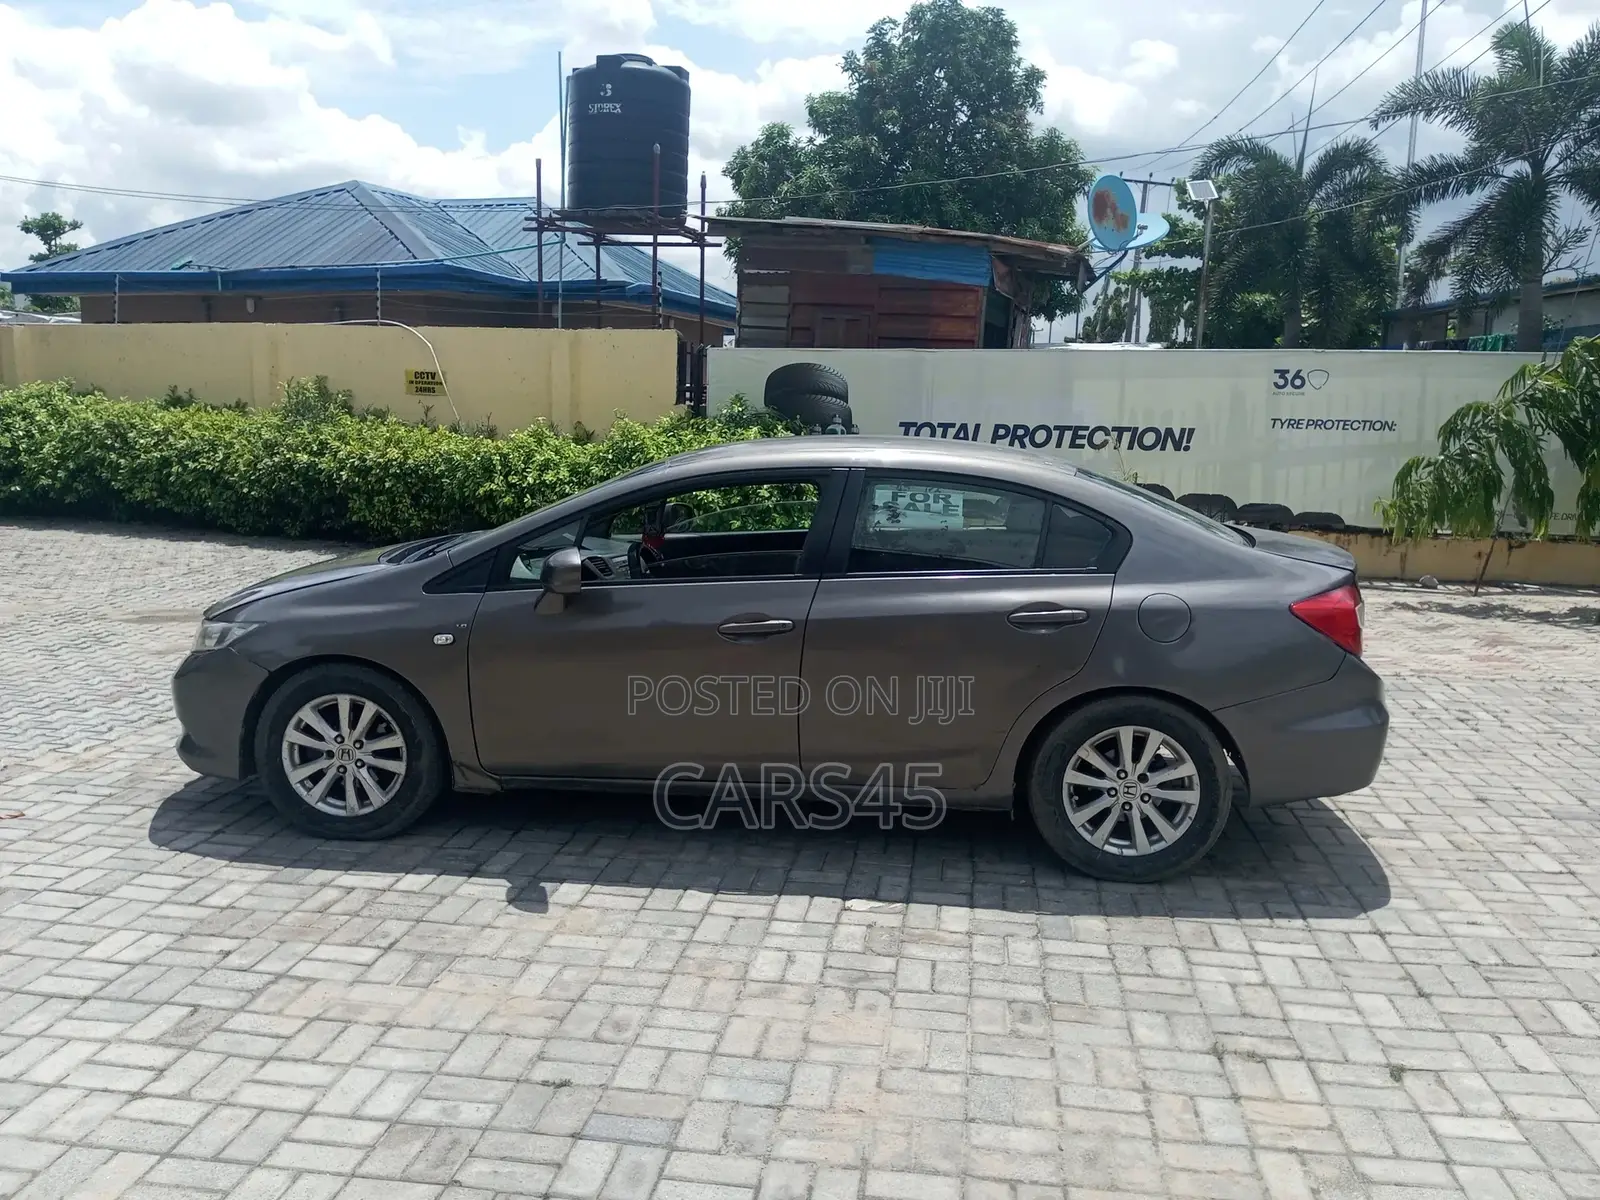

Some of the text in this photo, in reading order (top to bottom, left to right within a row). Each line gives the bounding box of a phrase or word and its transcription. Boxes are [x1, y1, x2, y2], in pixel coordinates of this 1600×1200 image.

[414, 371, 436, 380] CCTV
[415, 386, 436, 394] 24HRS
[990, 423, 1196, 452] PROTECTION!
[891, 491, 952, 505] FOR
